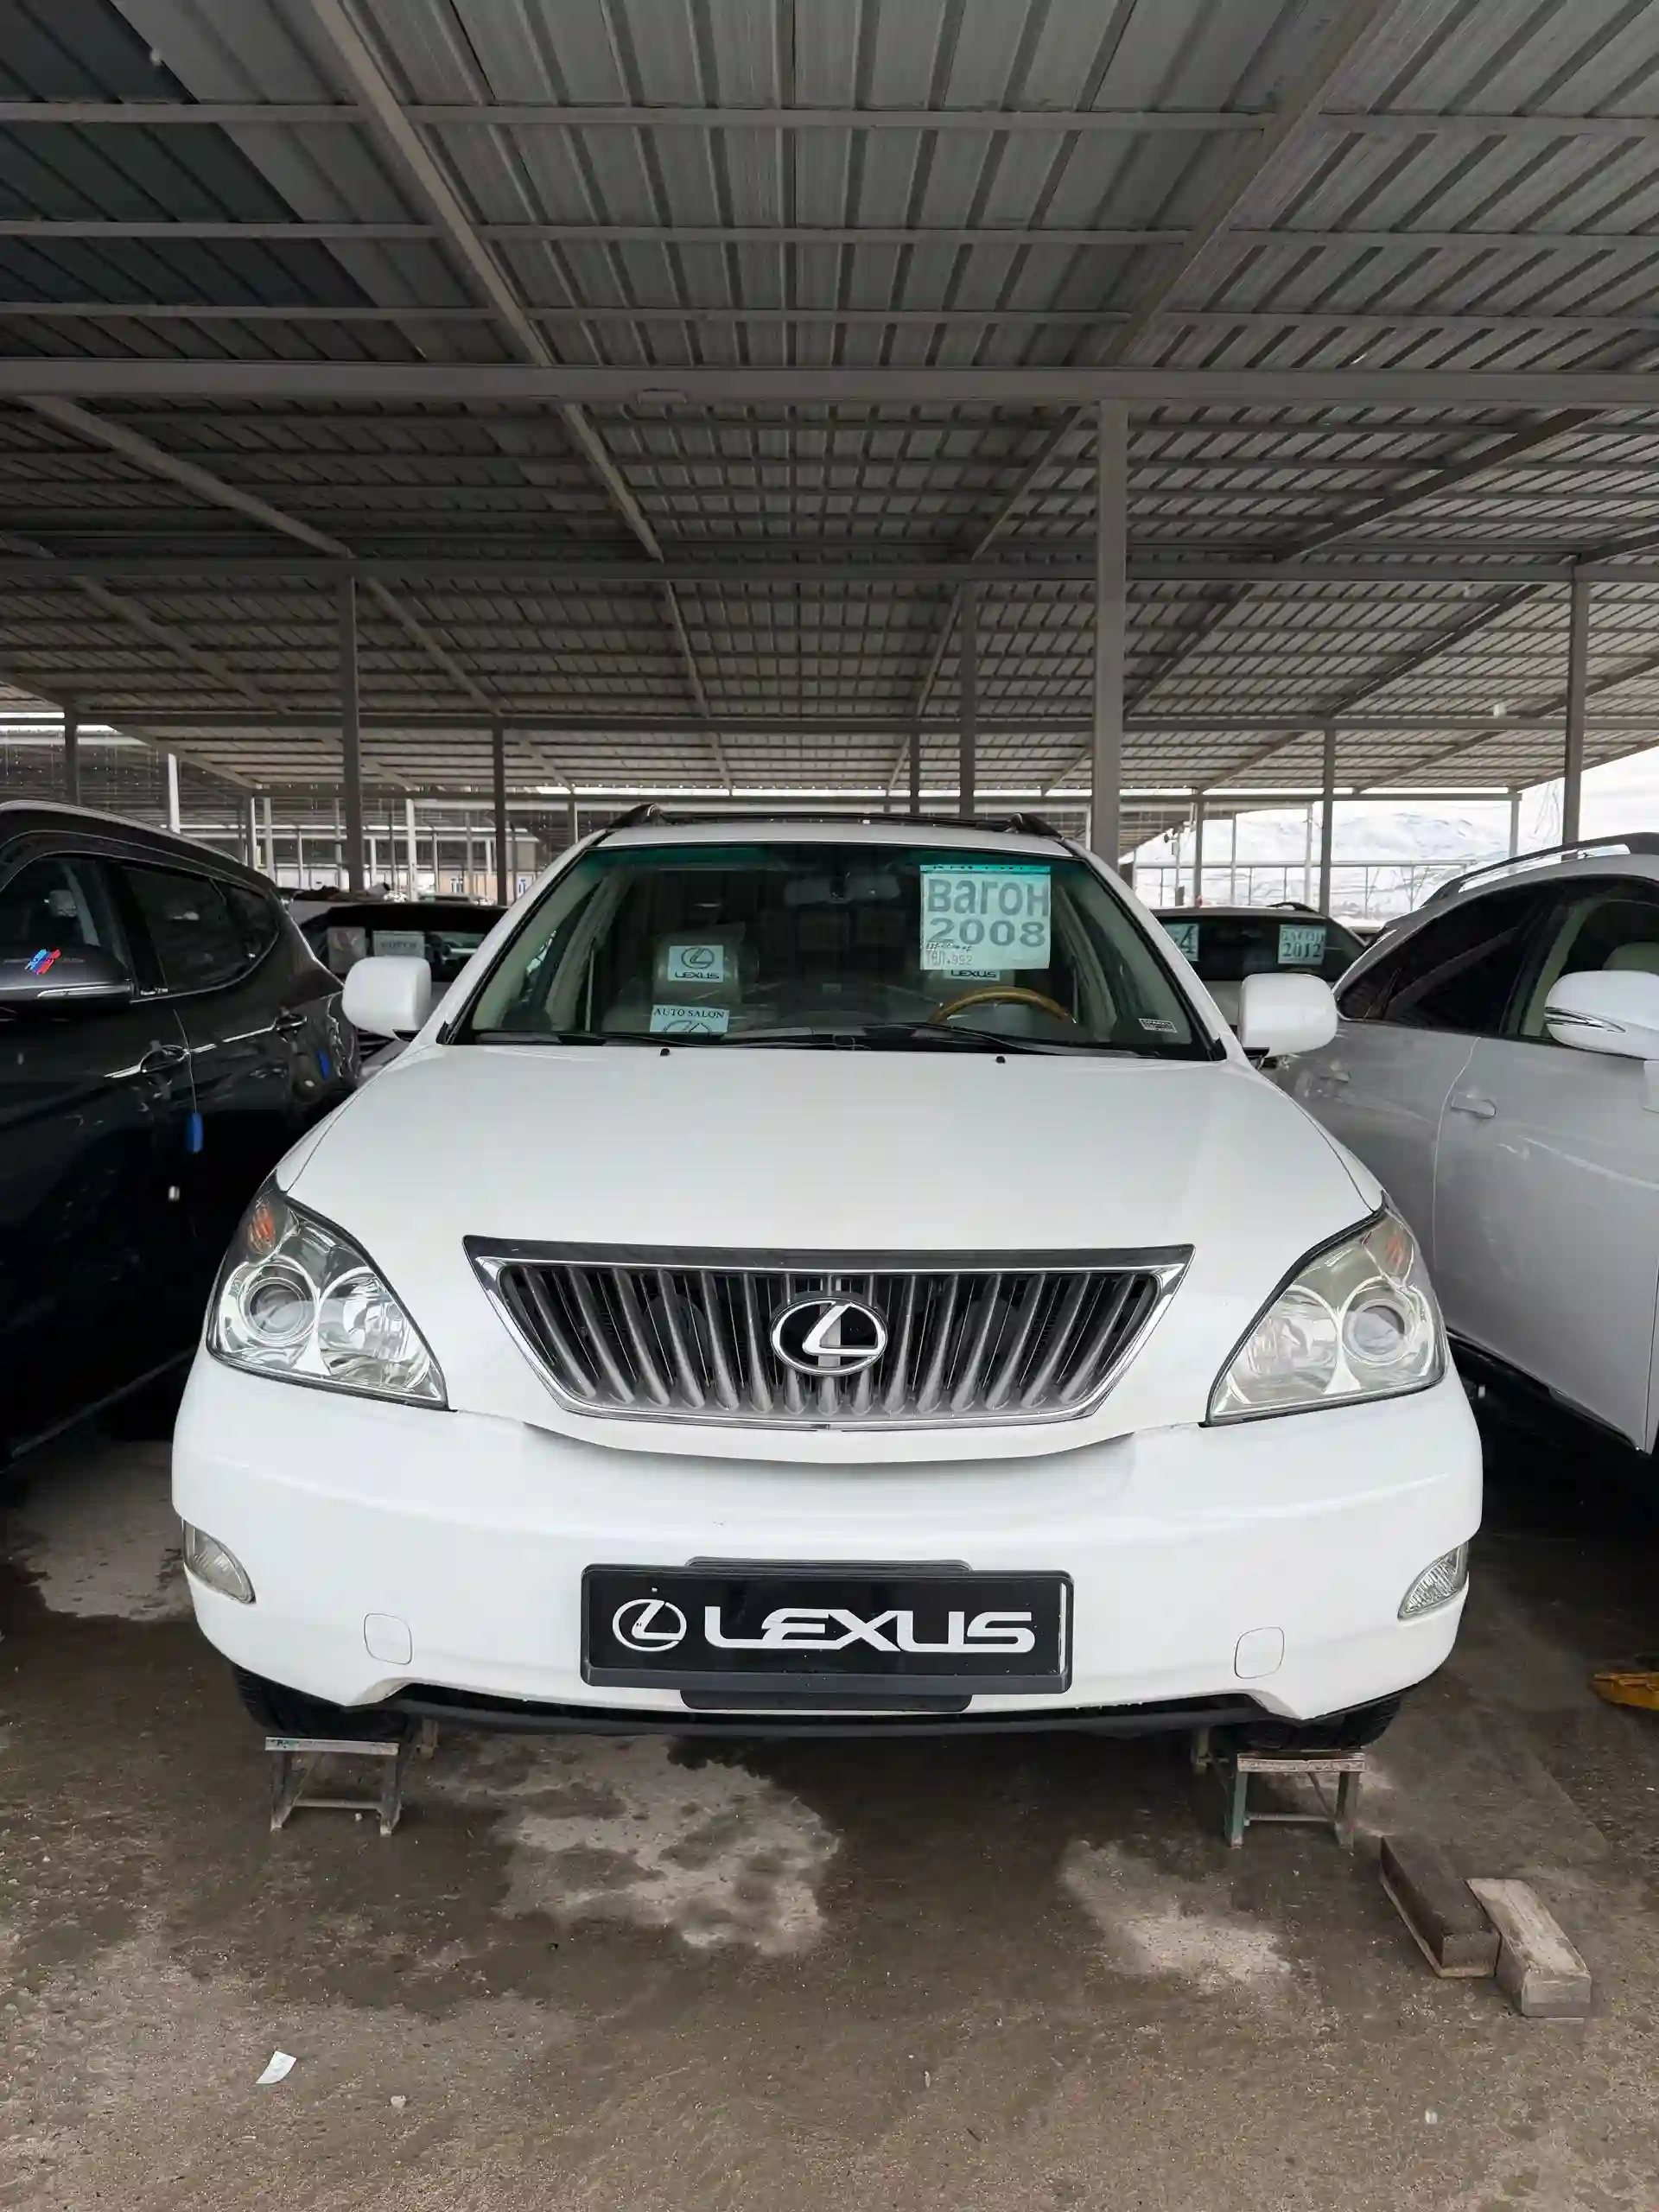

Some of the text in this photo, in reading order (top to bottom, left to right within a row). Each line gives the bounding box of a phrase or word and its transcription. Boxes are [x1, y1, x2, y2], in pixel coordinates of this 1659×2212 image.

[929, 918, 1046, 947] 2008
[950, 969, 997, 978] LEXUS
[653, 1007, 725, 1020] AUTO SALON
[704, 1605, 1036, 1654] LEXUS
